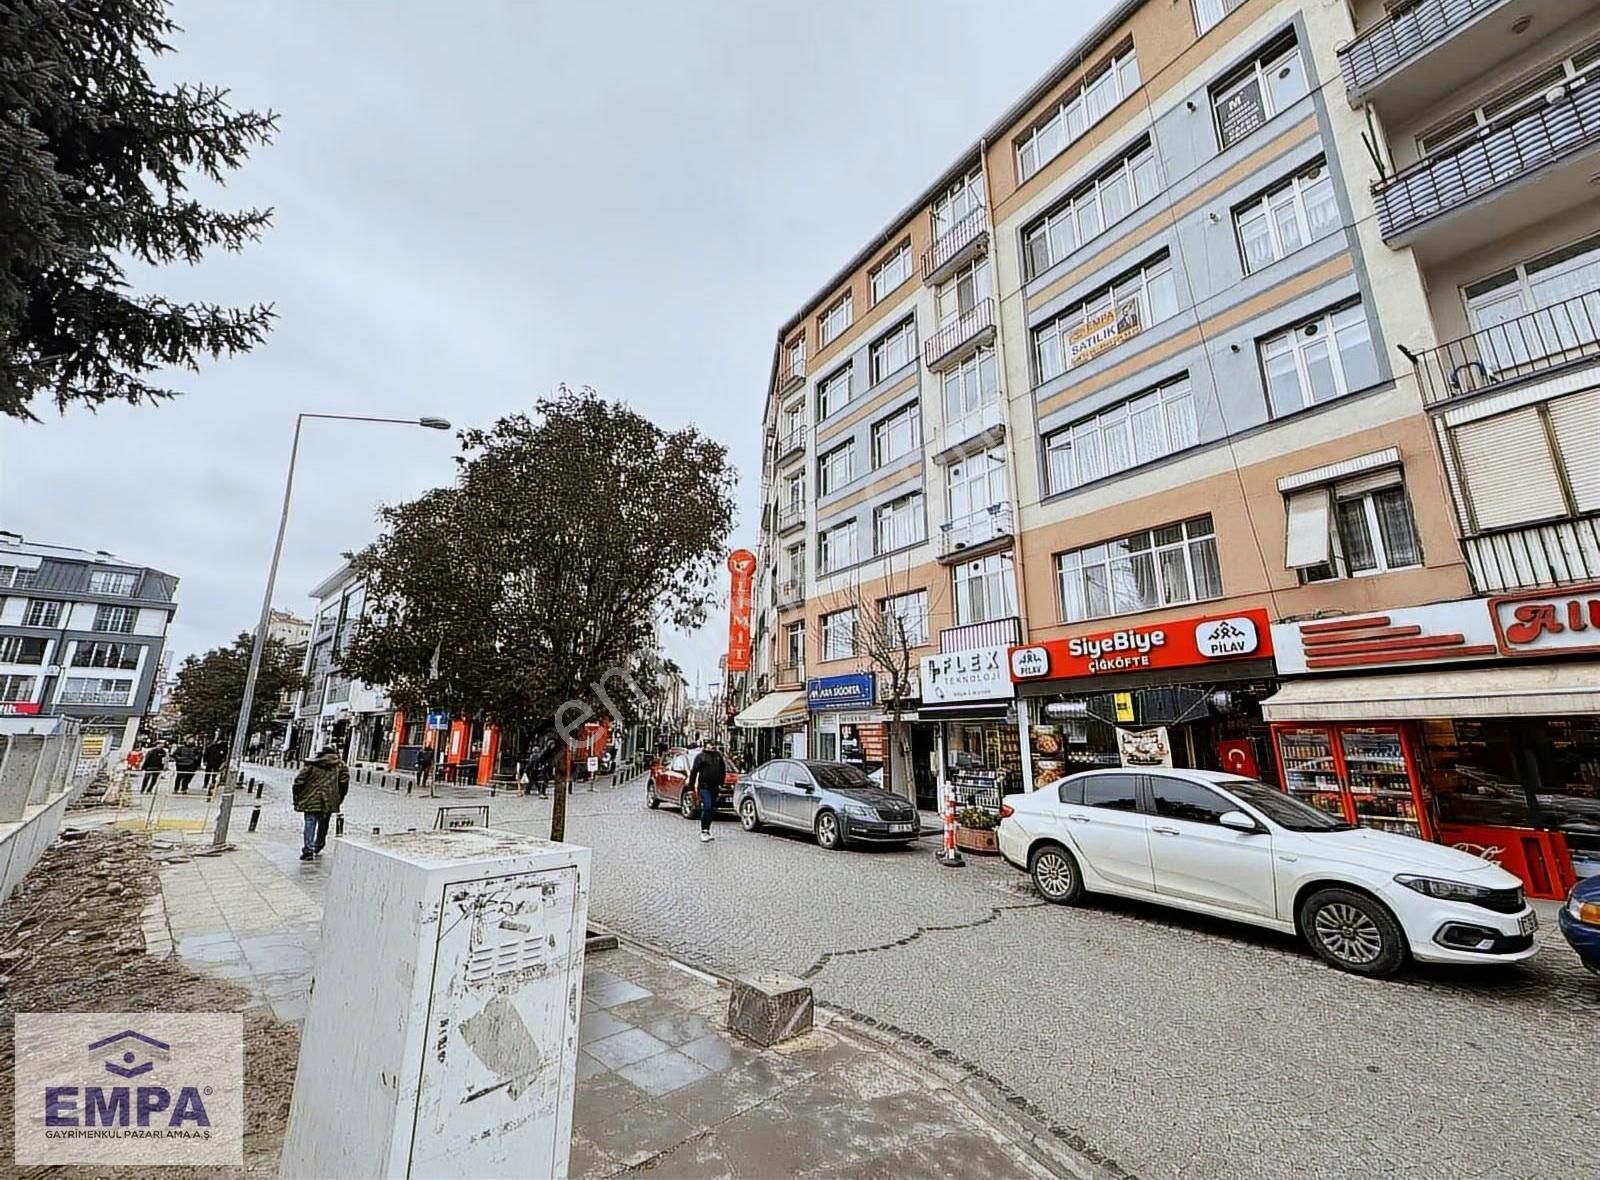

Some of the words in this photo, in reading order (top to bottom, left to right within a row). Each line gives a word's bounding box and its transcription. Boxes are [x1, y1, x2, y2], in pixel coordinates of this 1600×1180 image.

[1071, 327, 1116, 356] SATILIK
[1068, 629, 1166, 658] SiyeBiye
[1211, 640, 1245, 654] PİLAV
[943, 651, 999, 675] FLEX
